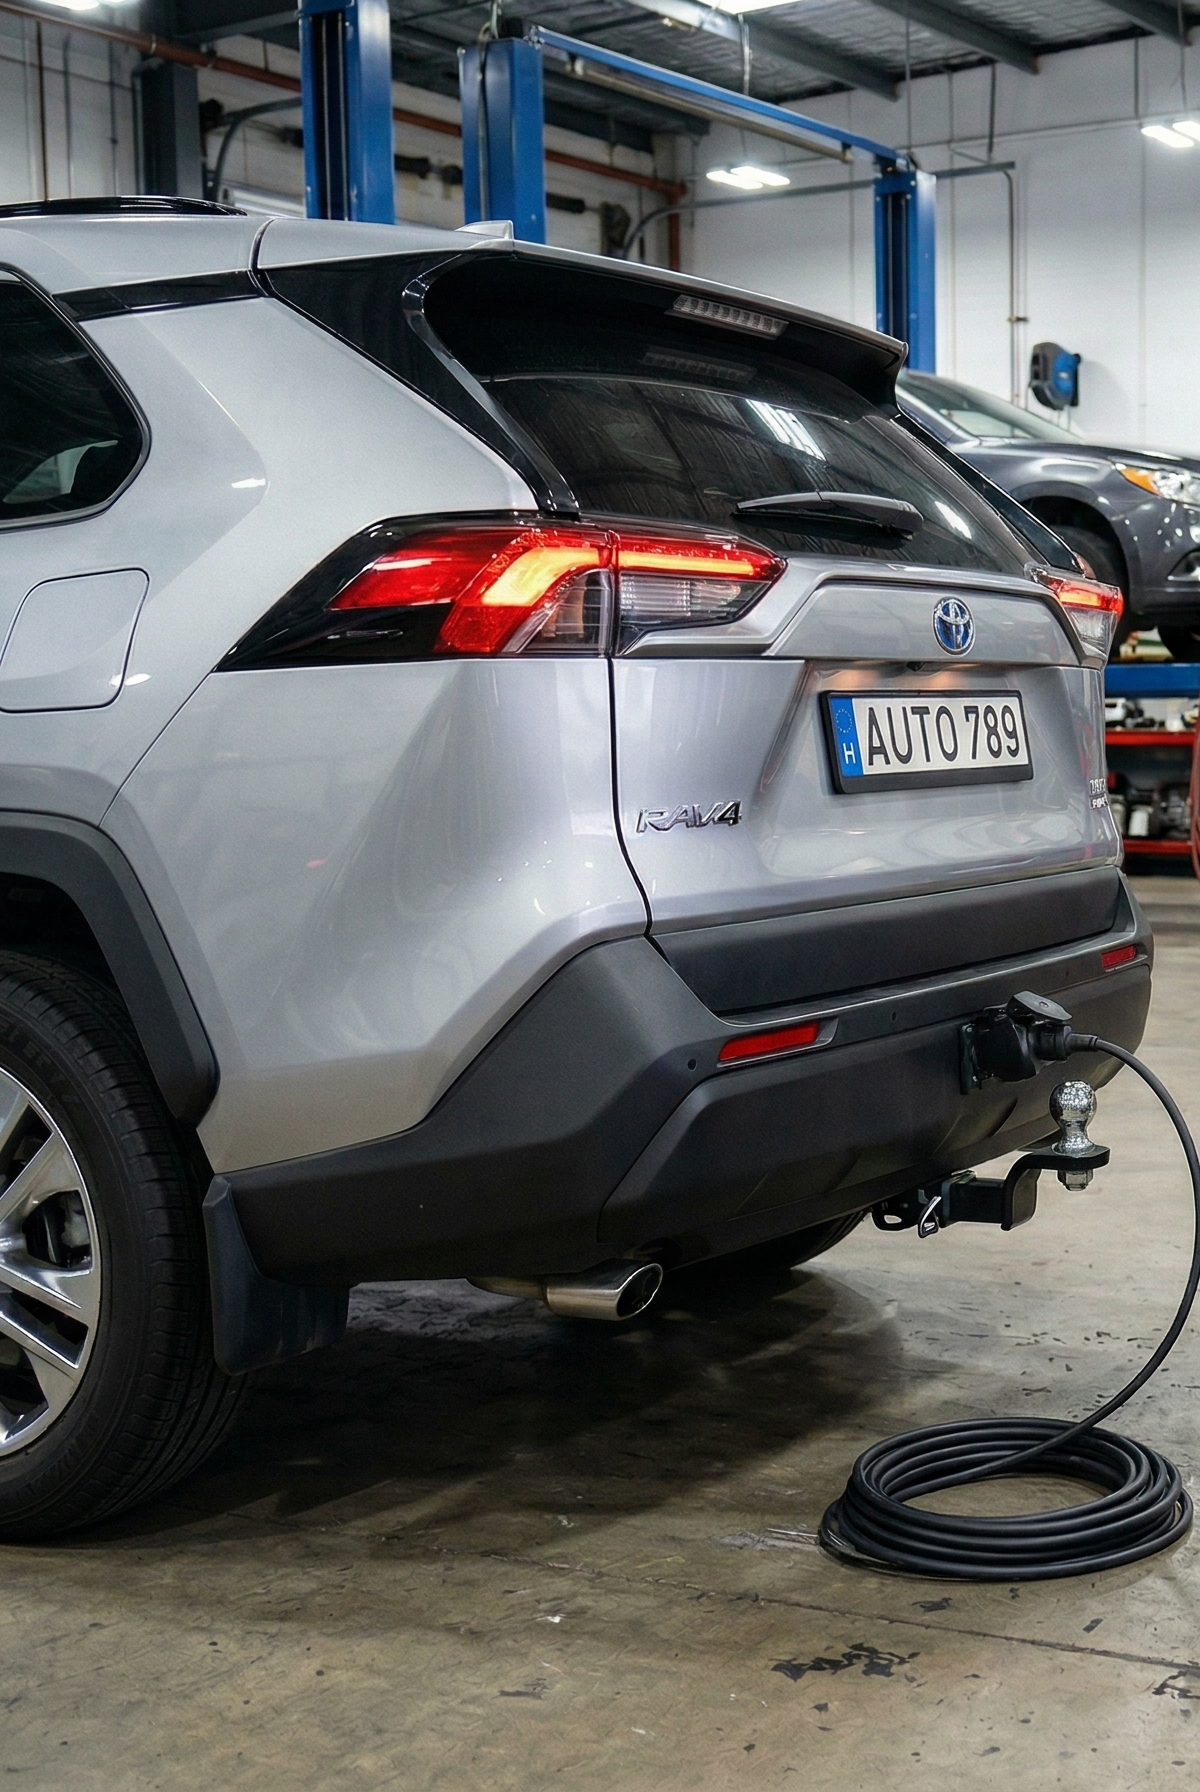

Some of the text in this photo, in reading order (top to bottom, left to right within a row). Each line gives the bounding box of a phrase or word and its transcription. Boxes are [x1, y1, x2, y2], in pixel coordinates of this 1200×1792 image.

[868, 704, 1020, 766] AUTO 789
[843, 742, 856, 765] H
[636, 799, 742, 834] RAV4
